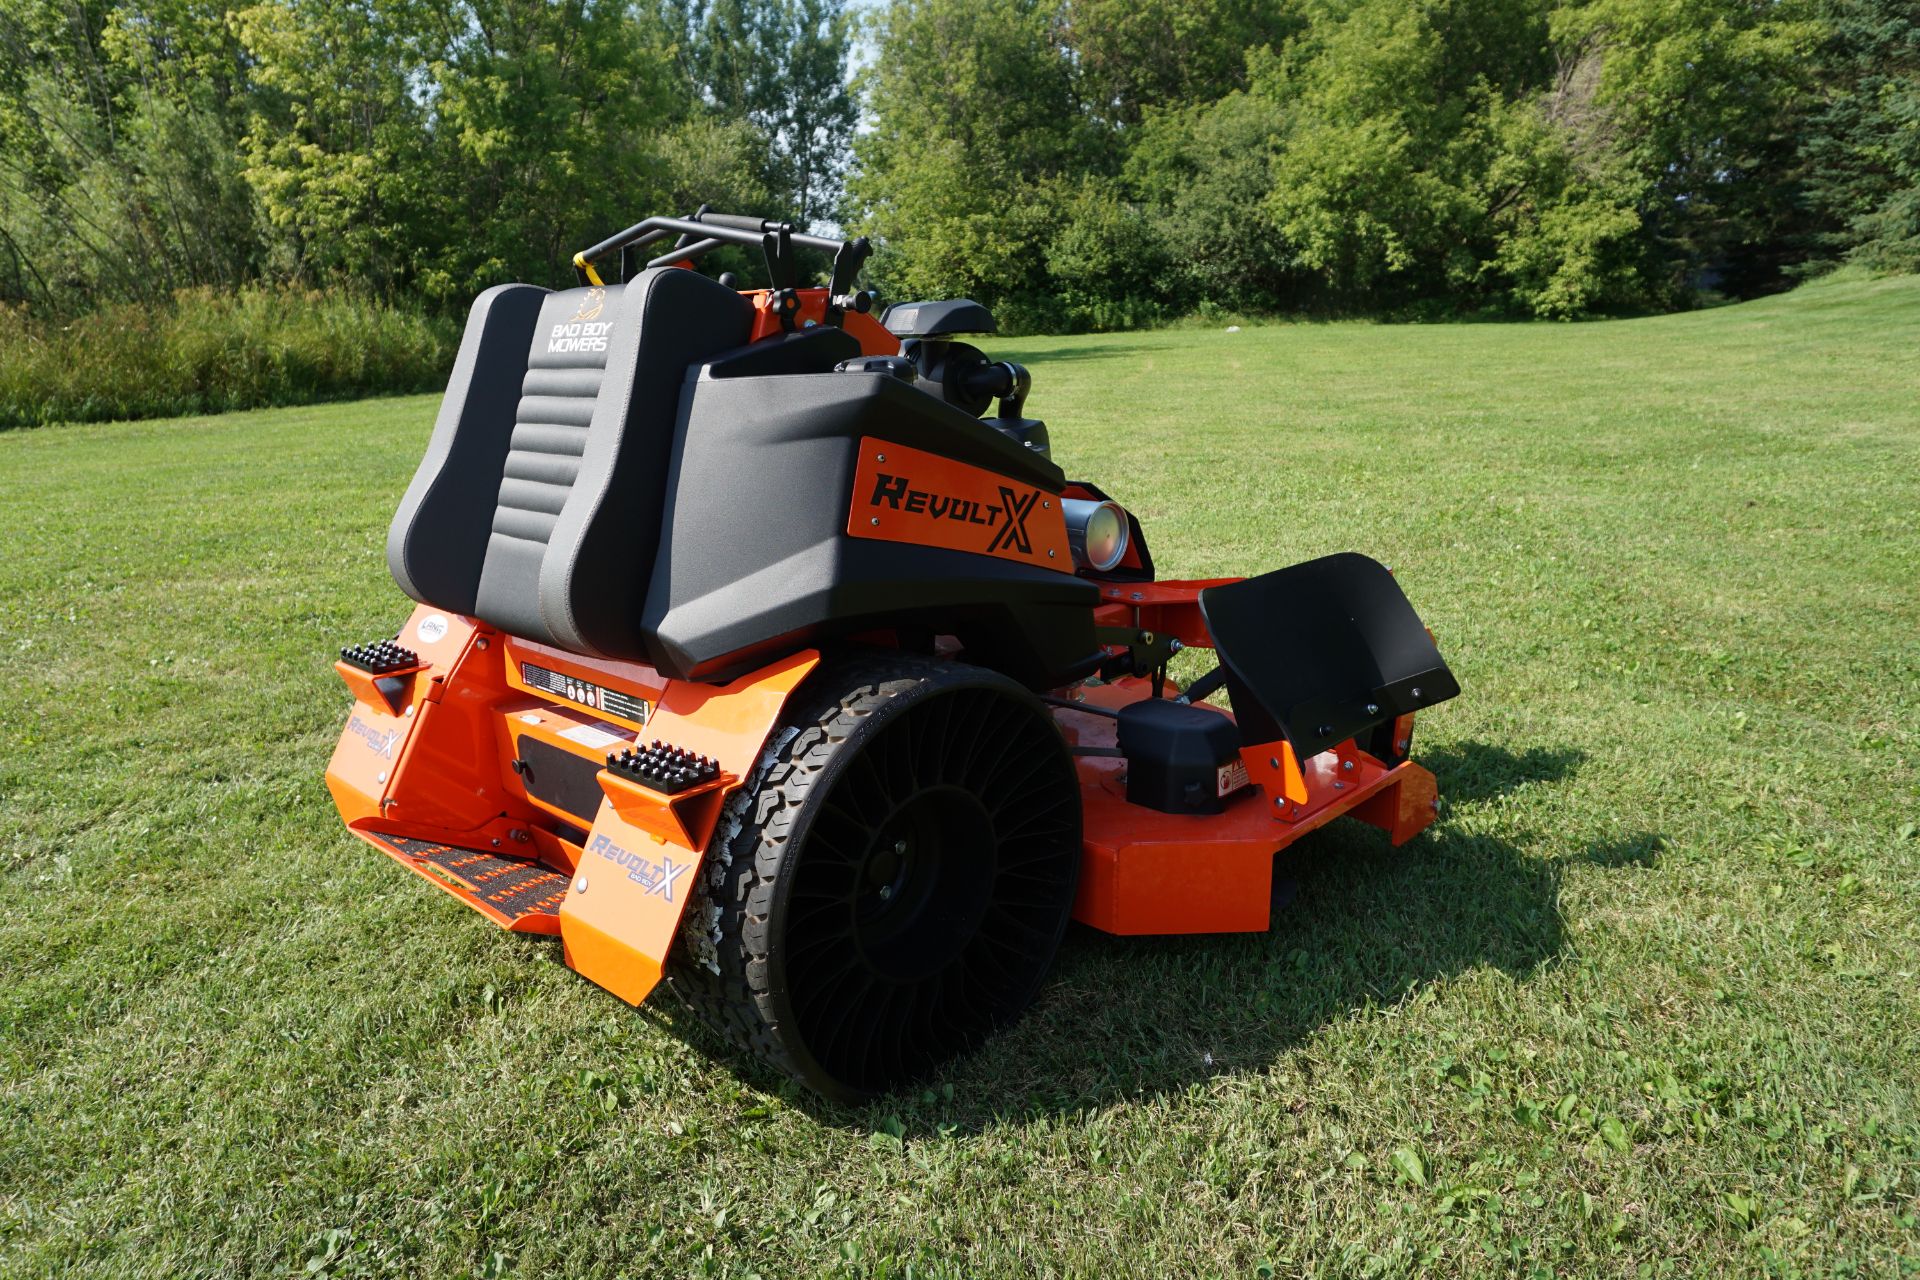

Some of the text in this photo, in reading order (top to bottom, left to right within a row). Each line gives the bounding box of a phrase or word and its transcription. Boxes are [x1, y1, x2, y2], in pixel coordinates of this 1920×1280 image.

[551, 321, 614, 338] BAD BOY
[547, 336, 608, 353] MOWERS
